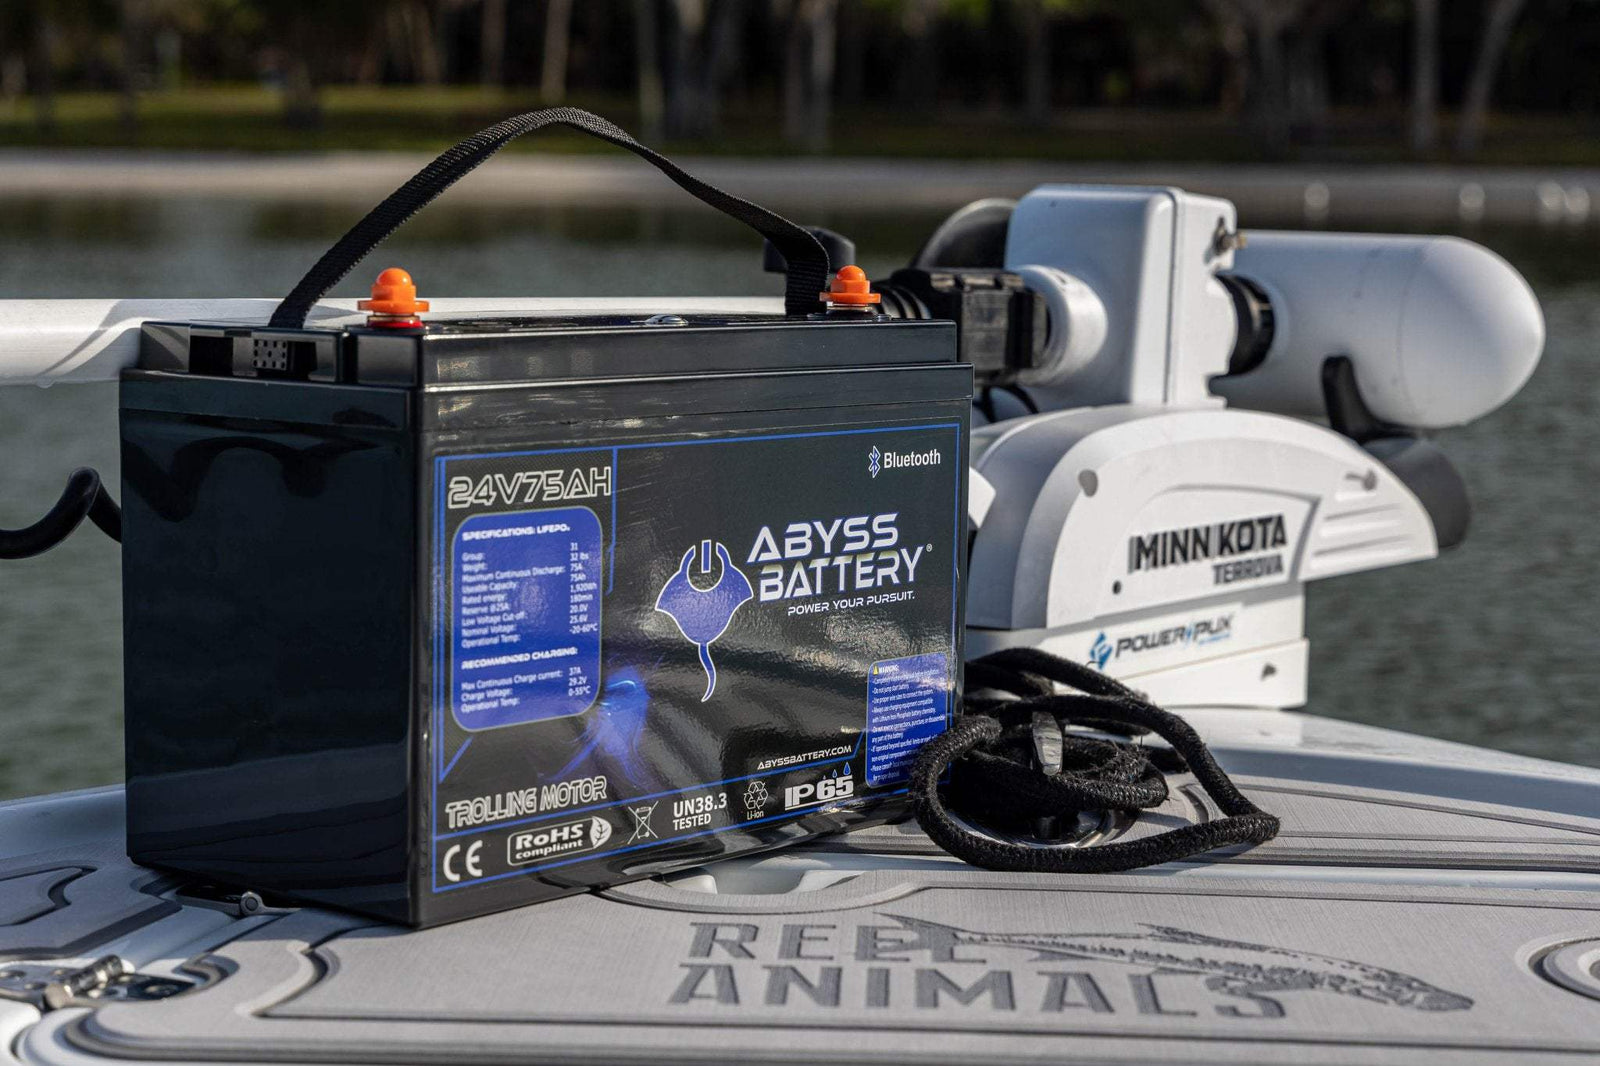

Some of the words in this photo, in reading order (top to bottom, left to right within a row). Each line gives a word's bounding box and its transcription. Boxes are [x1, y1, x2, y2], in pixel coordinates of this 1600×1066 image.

[884, 449, 940, 468] Bluetooth
[448, 467, 611, 509] 24V75AH
[462, 526, 535, 541] SPECIFICATIONS:
[746, 513, 898, 562] ABYSS
[1130, 525, 1211, 572] MINN
[1218, 514, 1288, 556] KOTA
[462, 552, 485, 561] Group:
[462, 562, 487, 571] Weight:
[462, 572, 494, 582] Maximum
[496, 569, 531, 579] Continuous
[533, 566, 565, 576] Discharge:
[570, 563, 582, 571] 75A
[570, 573, 586, 582] 75Ah
[760, 546, 924, 602] BATTERY
[1213, 554, 1284, 585] TERROVA
[462, 595, 481, 604] Rated
[483, 594, 507, 603] energy:
[788, 599, 830, 616] POWER
[833, 596, 864, 610] YOUR
[866, 590, 915, 605] PURSUIT.
[462, 616, 475, 626] Low
[477, 614, 501, 624] Voltage
[462, 627, 489, 636] Nominal
[491, 624, 517, 634] Voltage:
[570, 615, 588, 624] 25.6V
[462, 636, 499, 648] Operational
[501, 634, 521, 643] Temp:
[462, 652, 530, 670] RECOMMENDED
[532, 647, 578, 659] CHARGING:
[461, 692, 484, 702] Charge
[486, 688, 512, 698] Voltage:
[568, 676, 587, 686] 29.2V
[462, 682, 475, 690] Max
[477, 677, 512, 689] Continuous
[514, 674, 536, 683] Charge
[538, 670, 563, 680] current:
[569, 667, 582, 676] 37A
[461, 700, 498, 713] Operational
[501, 697, 520, 706] Temp:
[757, 745, 852, 770] ABYSSBATTERY.COM
[446, 788, 537, 829] TROLLING
[540, 776, 607, 812] MOTOR
[673, 792, 727, 818] UN38.3
[673, 814, 712, 830] TESTED
[746, 810, 764, 820] Li-ion
[516, 824, 584, 850] RoHS
[443, 840, 482, 882] CE
[516, 840, 583, 860] compliant
[688, 922, 987, 963] REEL
[669, 962, 1287, 1019] ANIMALS
